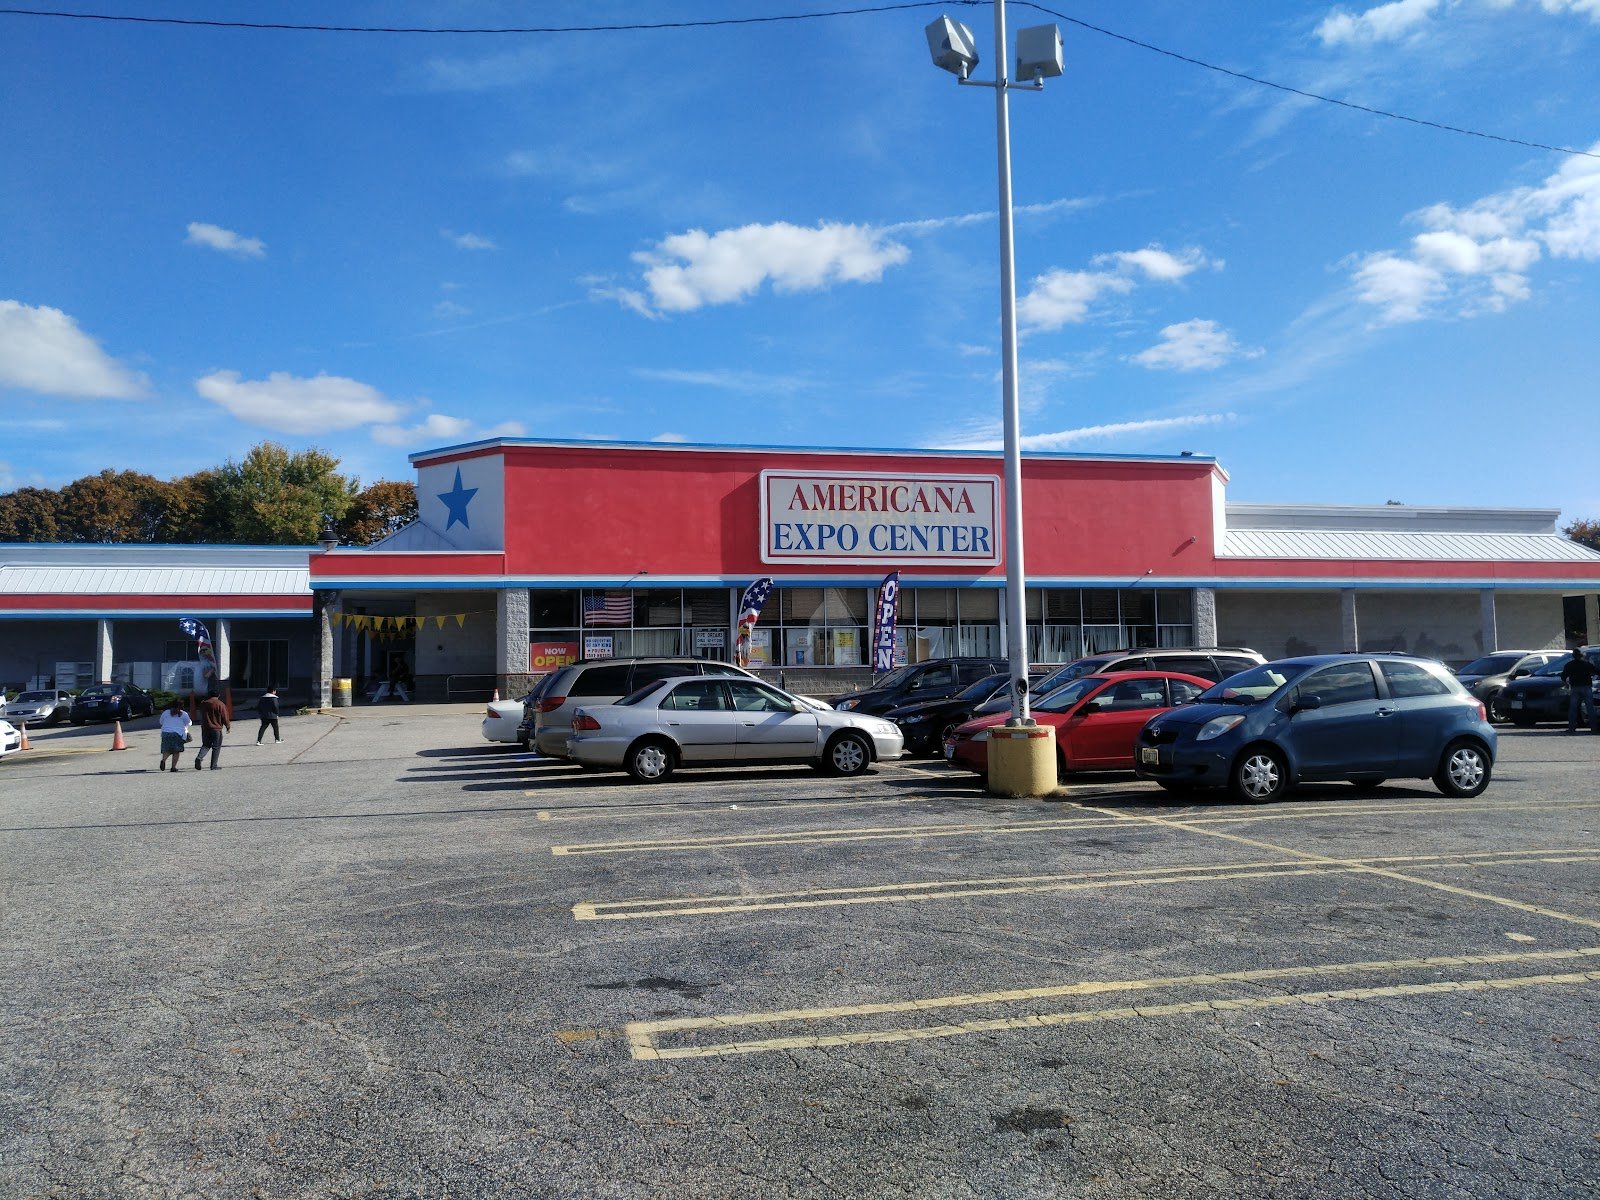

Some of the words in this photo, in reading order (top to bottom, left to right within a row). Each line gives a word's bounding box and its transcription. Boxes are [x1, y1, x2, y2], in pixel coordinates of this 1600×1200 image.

[788, 484, 976, 514] AMERICANA
[774, 523, 859, 551] EXPO
[868, 524, 991, 552] CENTER
[877, 580, 896, 669] OPEN
[534, 655, 576, 667] OPEN
